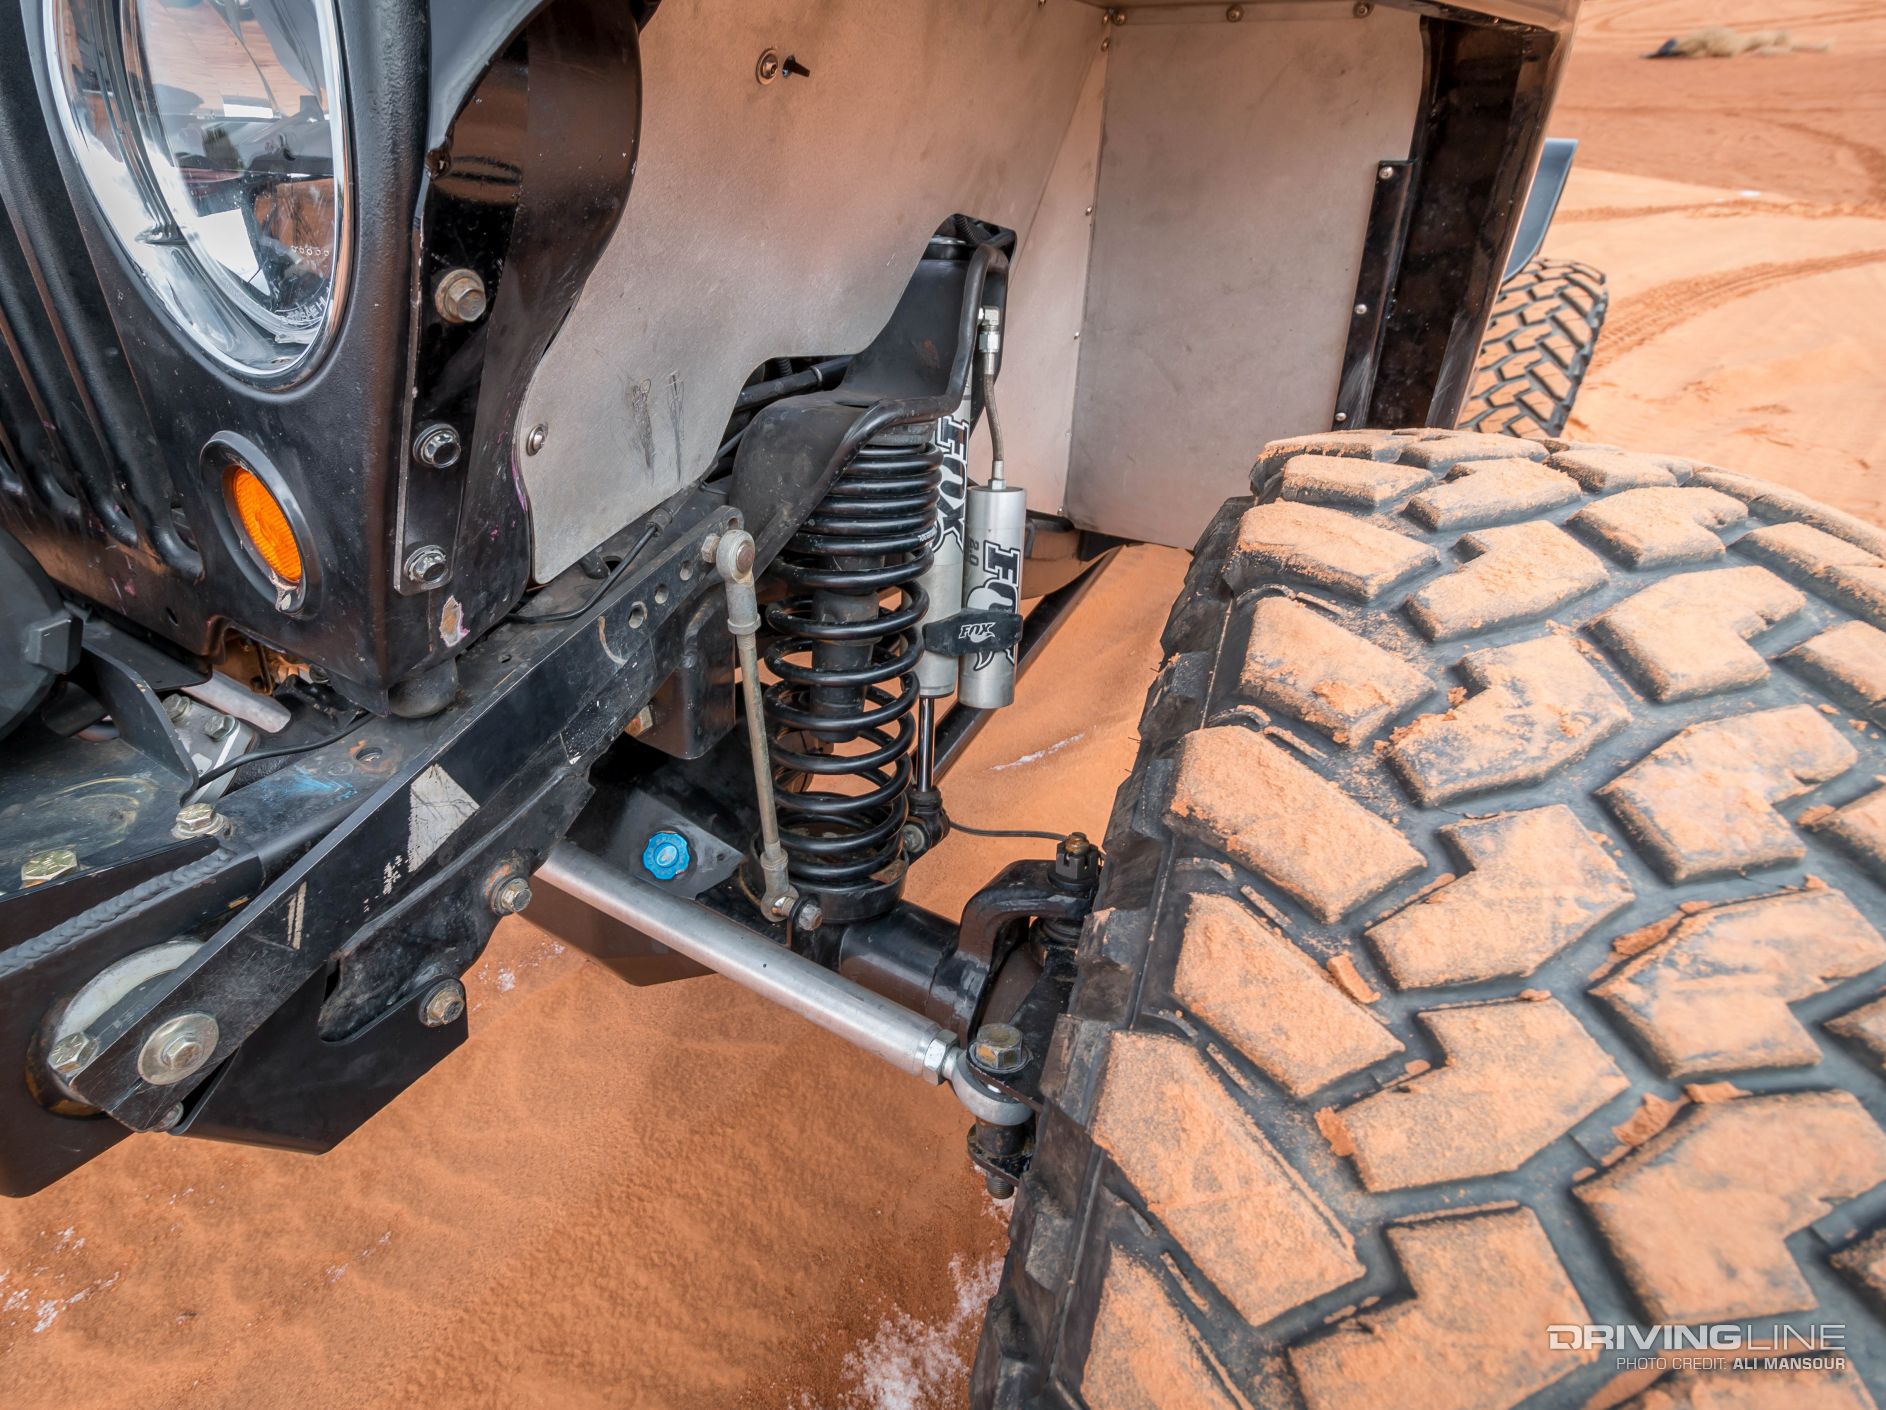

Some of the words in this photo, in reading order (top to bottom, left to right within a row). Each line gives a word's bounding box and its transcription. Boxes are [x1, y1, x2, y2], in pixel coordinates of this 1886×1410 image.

[933, 416, 969, 551] FOX
[967, 537, 980, 567] 2.0
[958, 622, 996, 643] FOX
